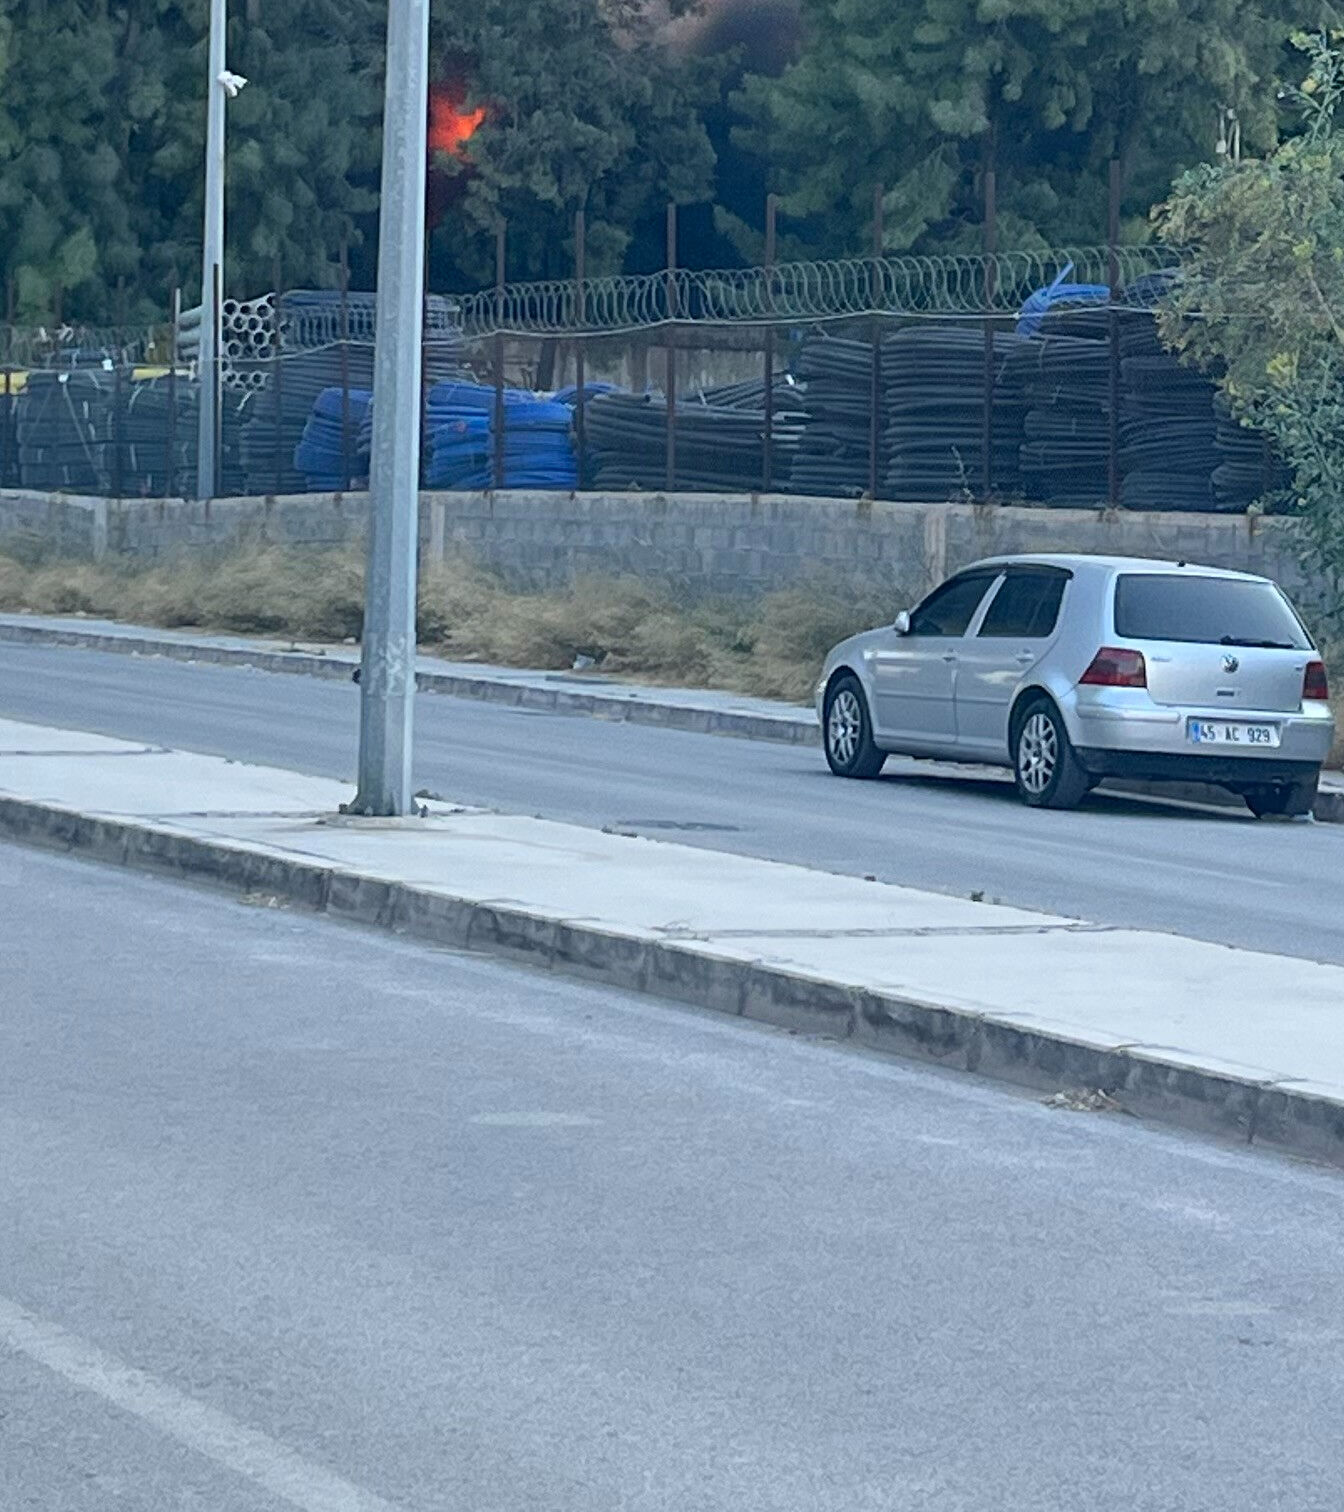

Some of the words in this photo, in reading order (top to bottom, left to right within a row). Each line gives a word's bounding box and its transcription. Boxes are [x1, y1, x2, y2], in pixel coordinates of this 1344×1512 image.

[1200, 725, 1216, 741] 45
[1225, 726, 1240, 742] AC
[1247, 727, 1271, 743] 929
